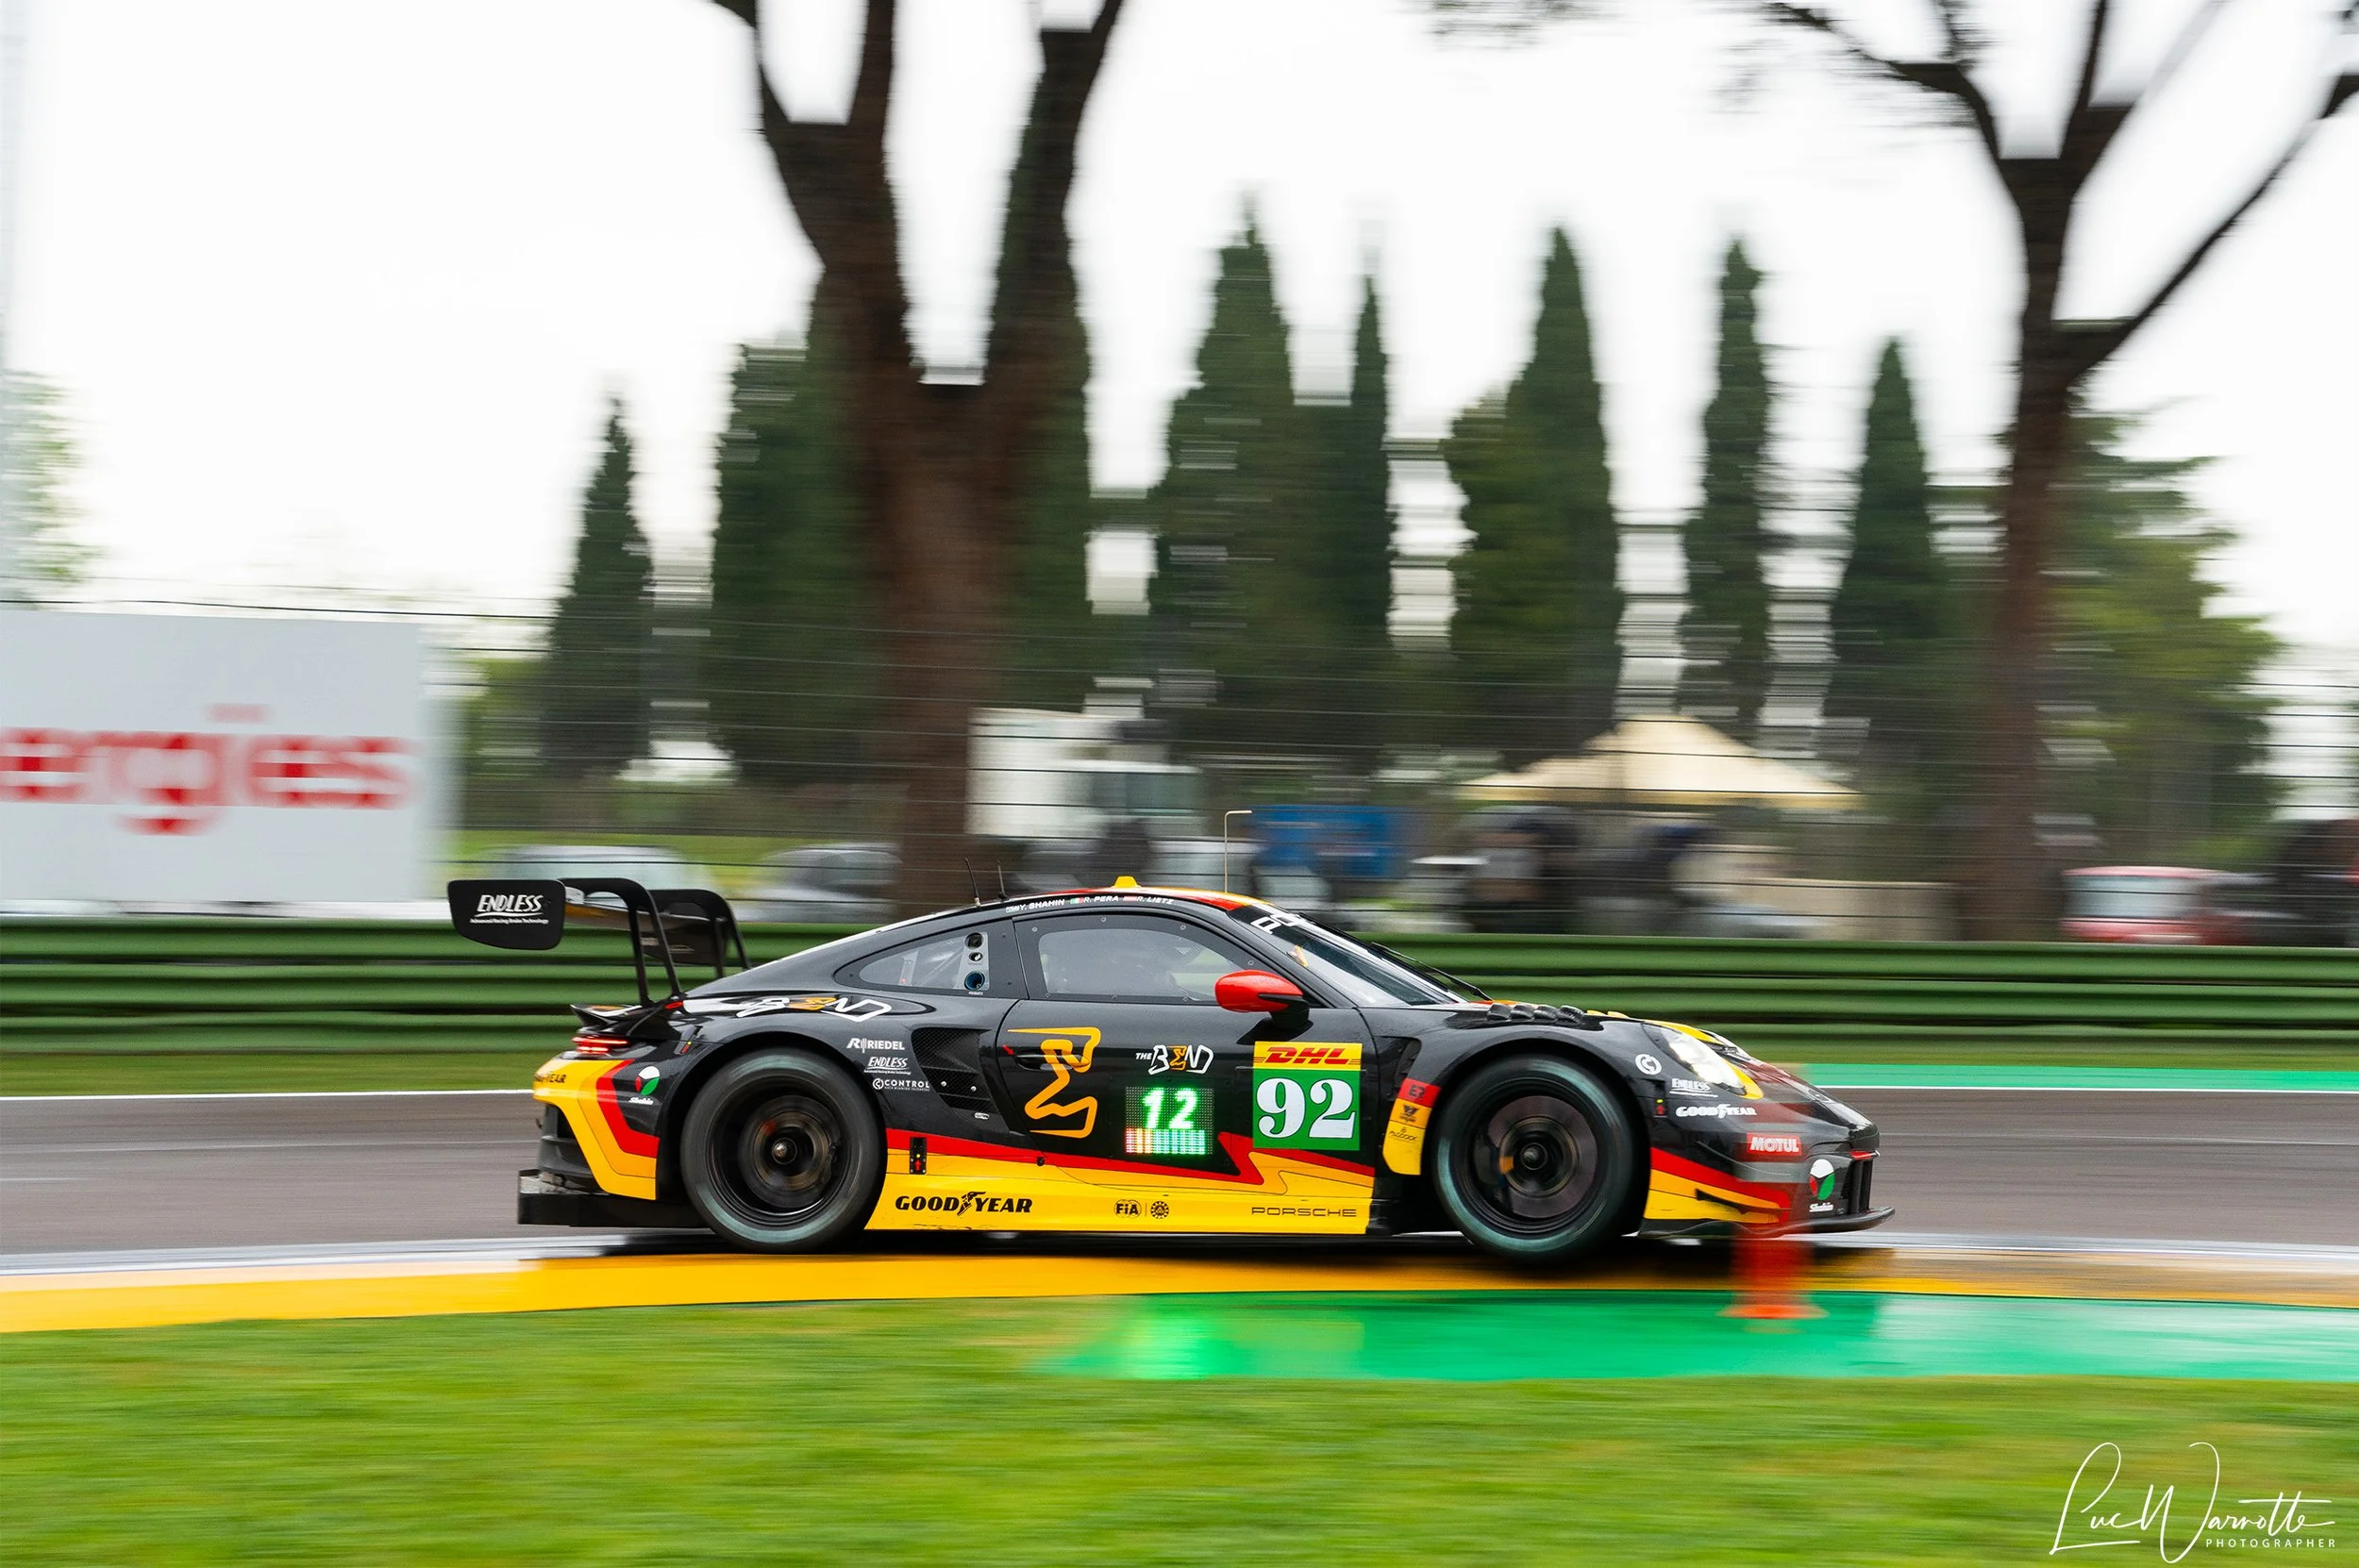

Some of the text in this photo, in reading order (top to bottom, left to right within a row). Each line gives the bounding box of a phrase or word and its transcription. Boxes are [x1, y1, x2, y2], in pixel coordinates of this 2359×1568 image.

[477, 894, 544, 912] ENDLESS
[1029, 899, 1065, 910] SHAHIN
[867, 1040, 905, 1051] RIEDEL
[868, 1057, 908, 1068] ENDLESS
[1135, 1052, 1153, 1060] THE
[1265, 1046, 1349, 1065] DHL
[884, 1079, 930, 1089] CONTROL
[1143, 1087, 1197, 1129] 12
[1256, 1077, 1356, 1139] 92
[1675, 1103, 1758, 1119] GOODYEAR
[1749, 1136, 1800, 1153] MOTUL
[895, 1193, 1033, 1216] GOODYEAR
[1251, 1207, 1357, 1217] PORSCHE
